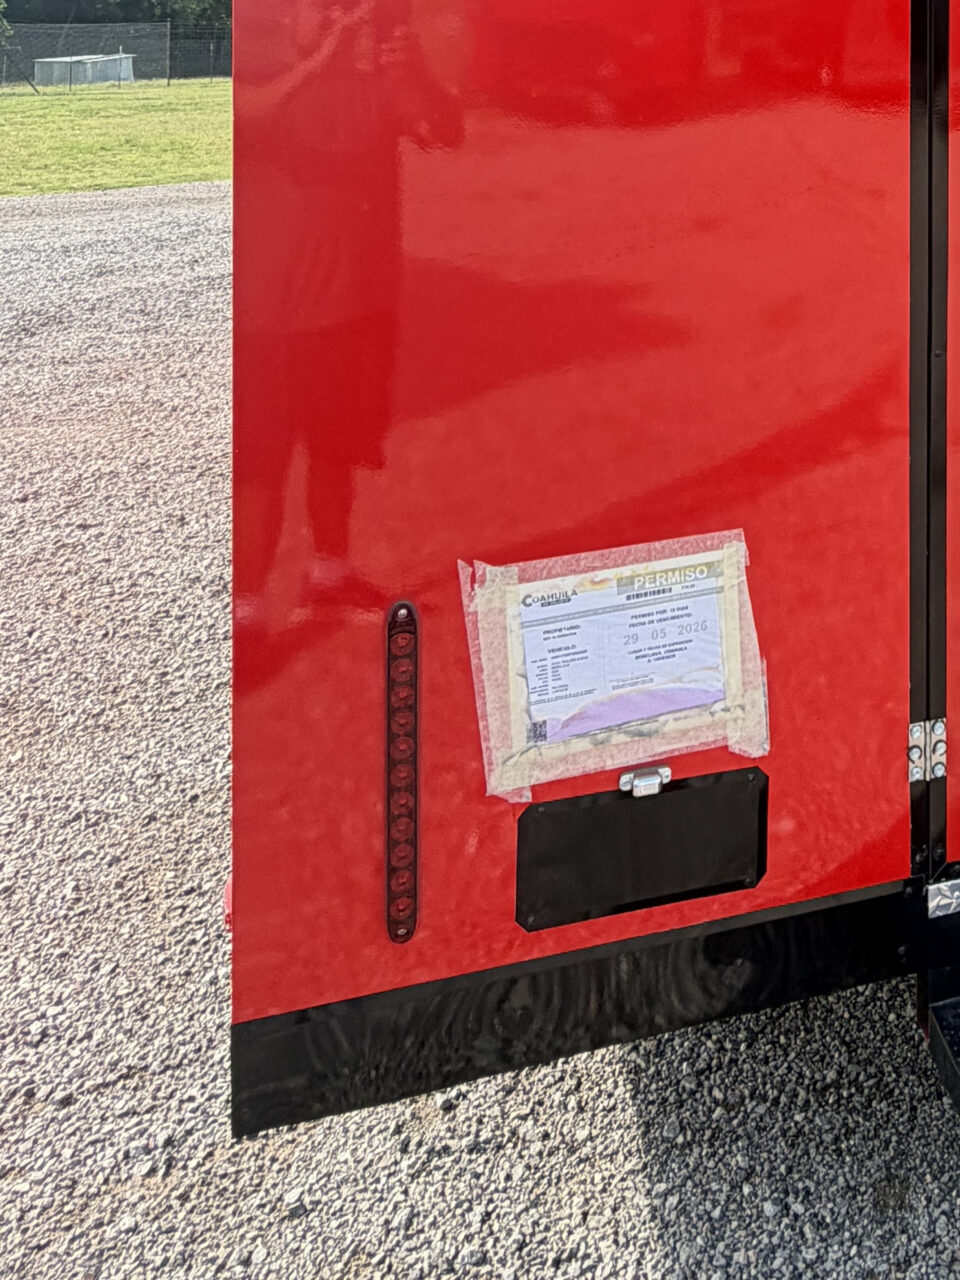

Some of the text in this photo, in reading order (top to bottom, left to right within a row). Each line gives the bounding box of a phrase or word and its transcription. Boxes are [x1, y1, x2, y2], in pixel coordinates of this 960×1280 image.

[634, 566, 708, 590] PERMISO
[521, 589, 578, 608] COAHUILA
[623, 620, 708, 646] 29 05 2026
